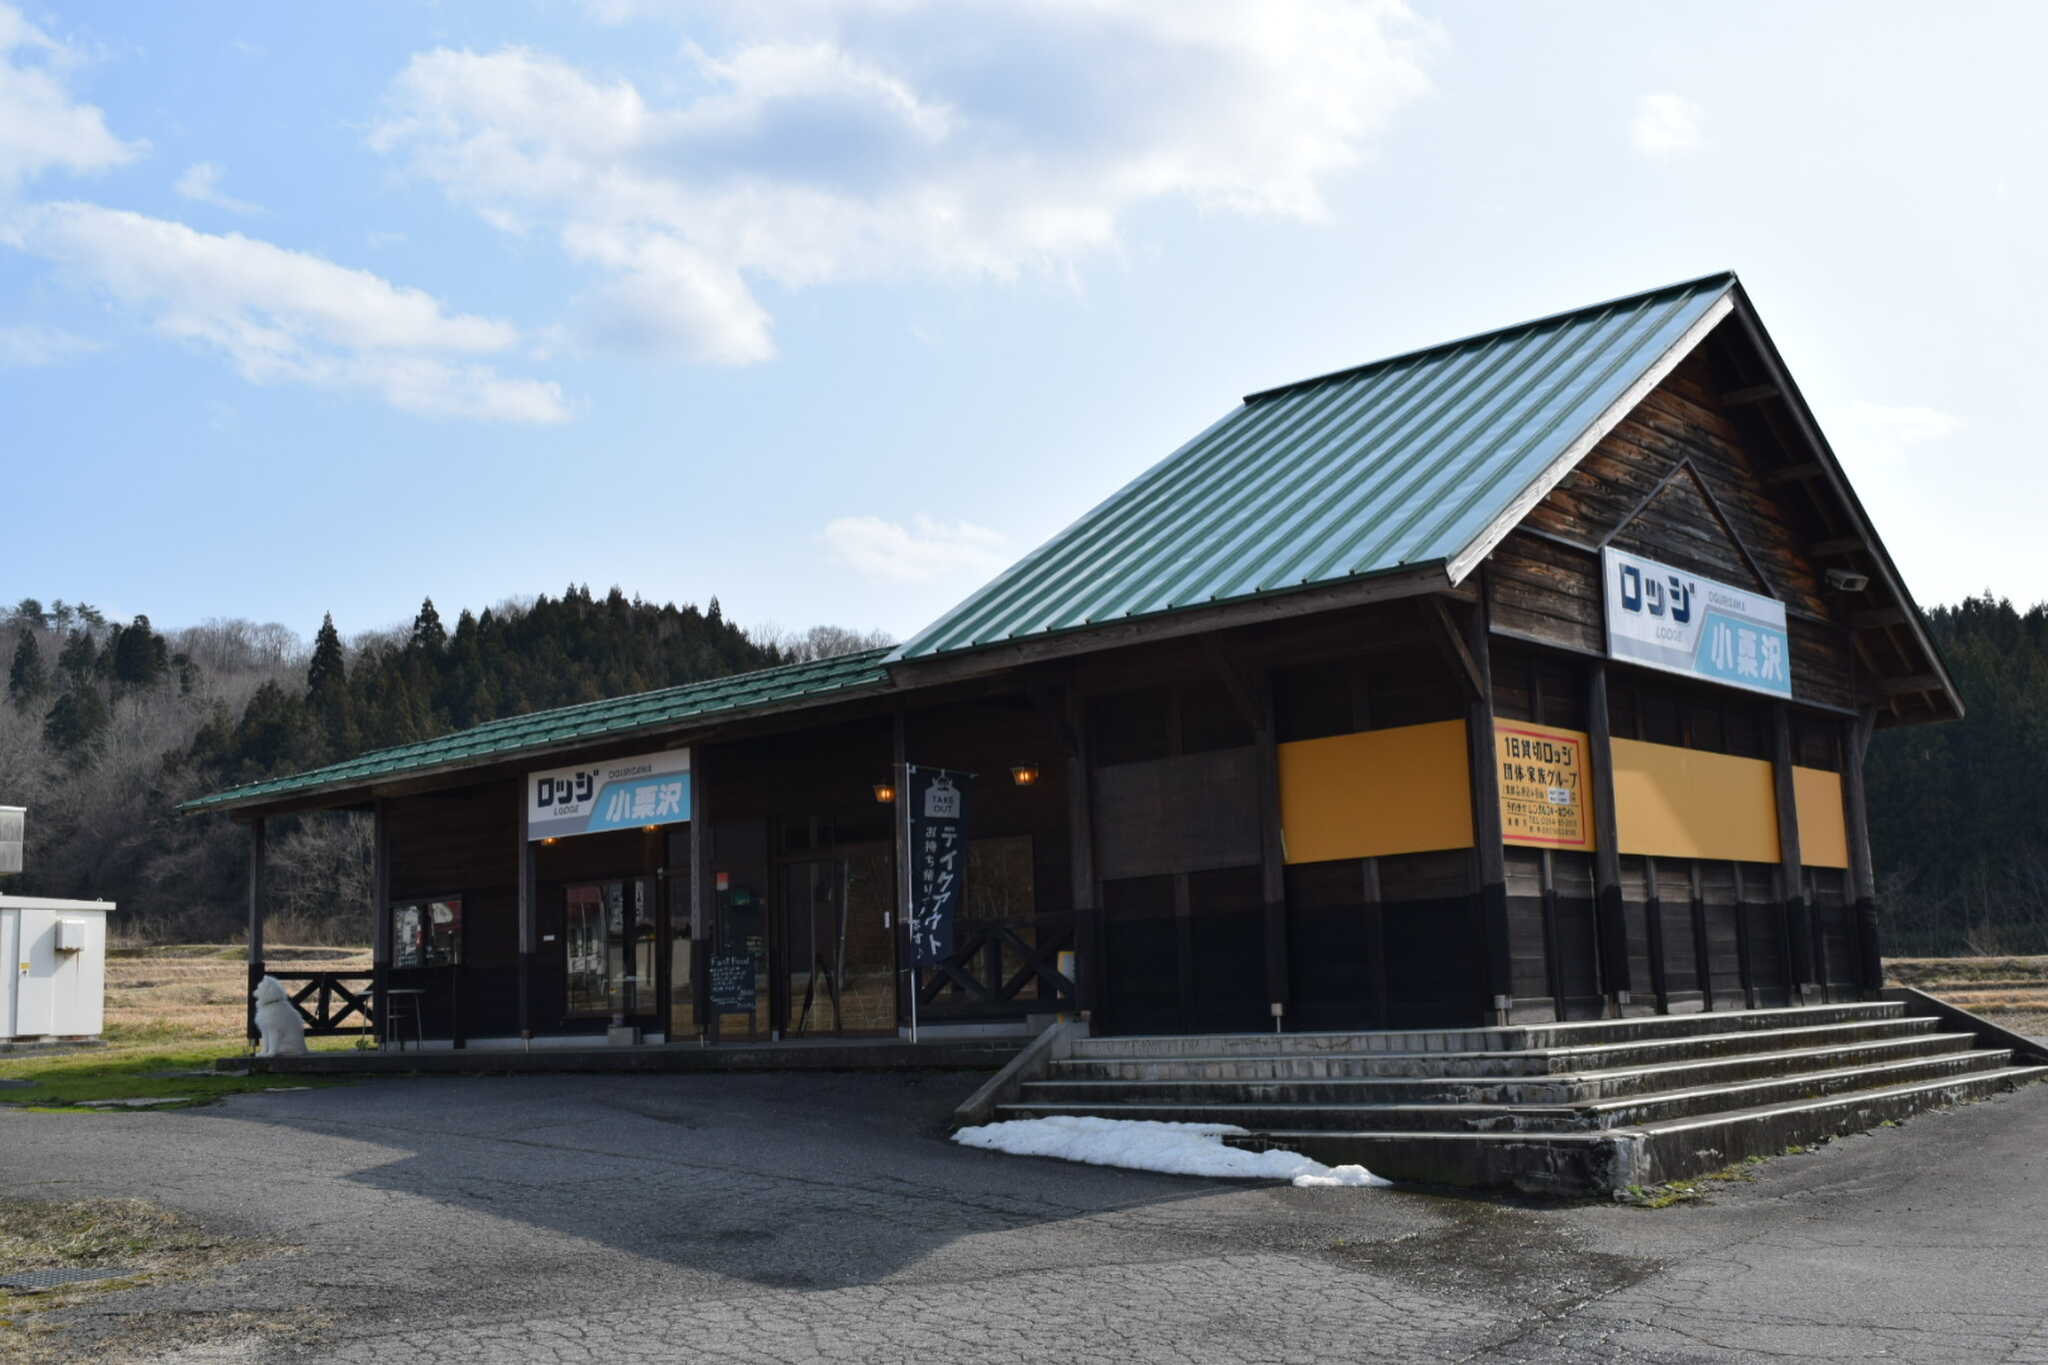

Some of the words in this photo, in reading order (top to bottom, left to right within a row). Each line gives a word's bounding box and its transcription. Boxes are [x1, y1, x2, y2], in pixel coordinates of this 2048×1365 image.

[1621, 565, 1695, 623] ロッジ
[1656, 625, 1683, 643] LODGE
[1505, 737, 1573, 766] 1日貸切ロッジ
[538, 769, 599, 807] ロッジ
[554, 804, 579, 816] LODGE
[932, 796, 954, 804] TAKE
[934, 804, 953, 812] OUT
[924, 826, 958, 956] テイクアウト
